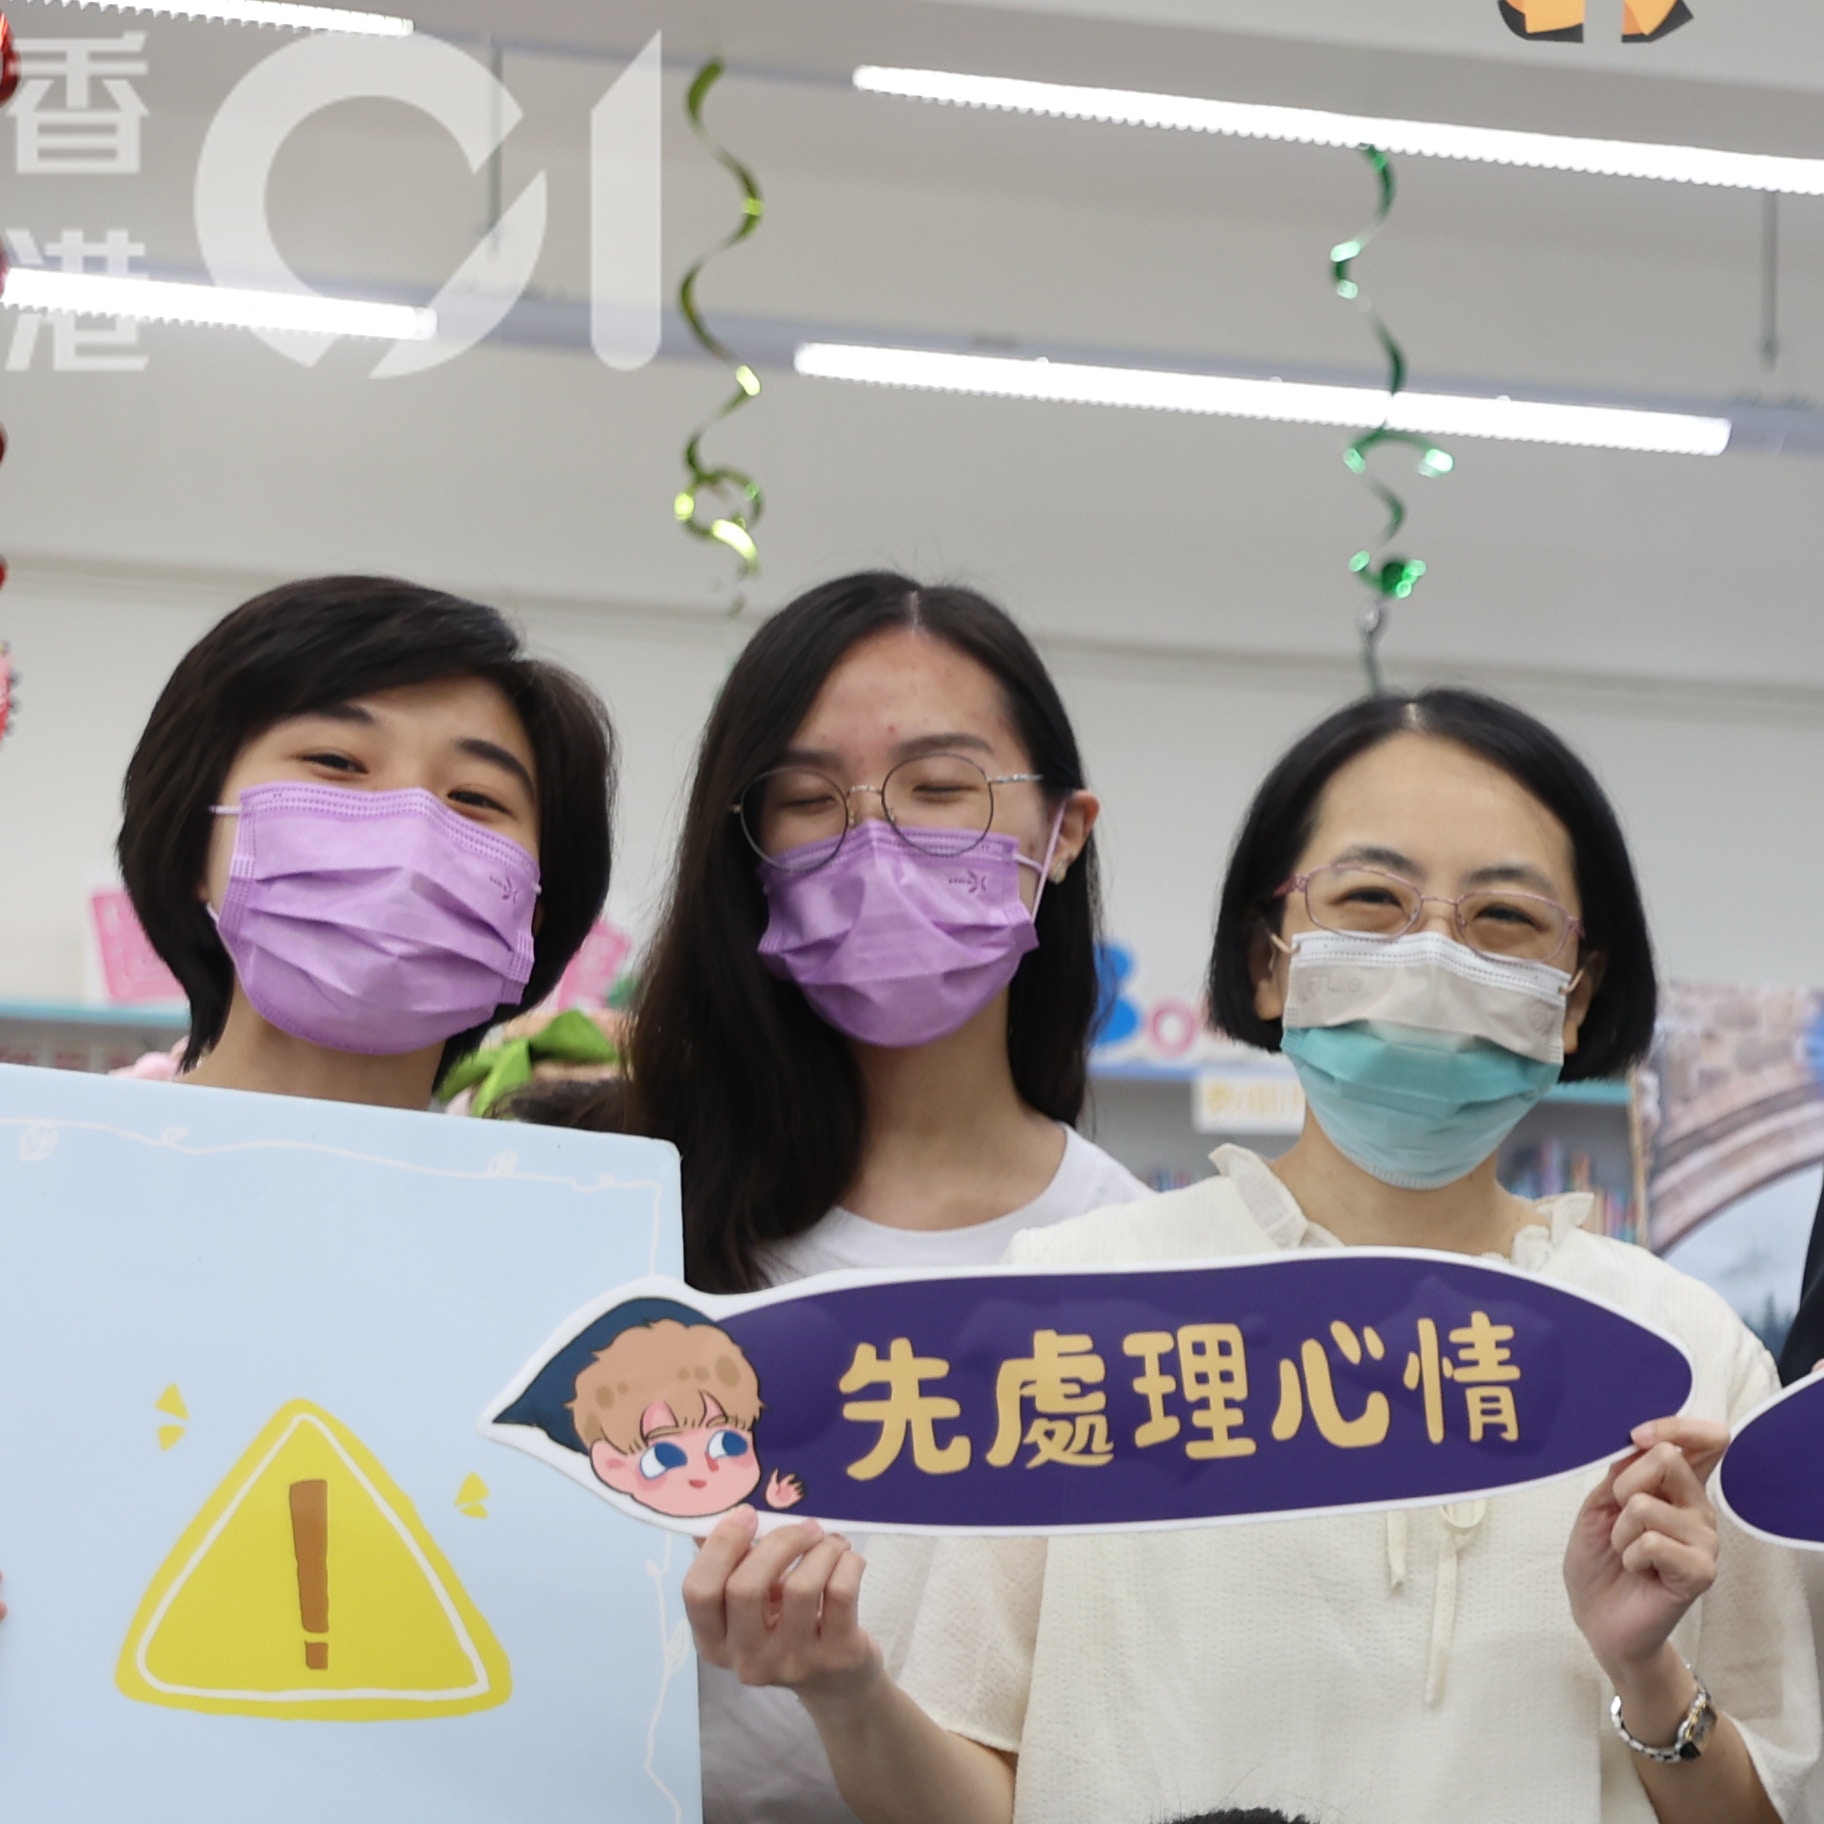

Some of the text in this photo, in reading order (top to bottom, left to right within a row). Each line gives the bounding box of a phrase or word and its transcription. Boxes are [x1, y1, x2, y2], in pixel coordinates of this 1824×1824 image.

[838, 1311, 1521, 1480] 先處理心情
